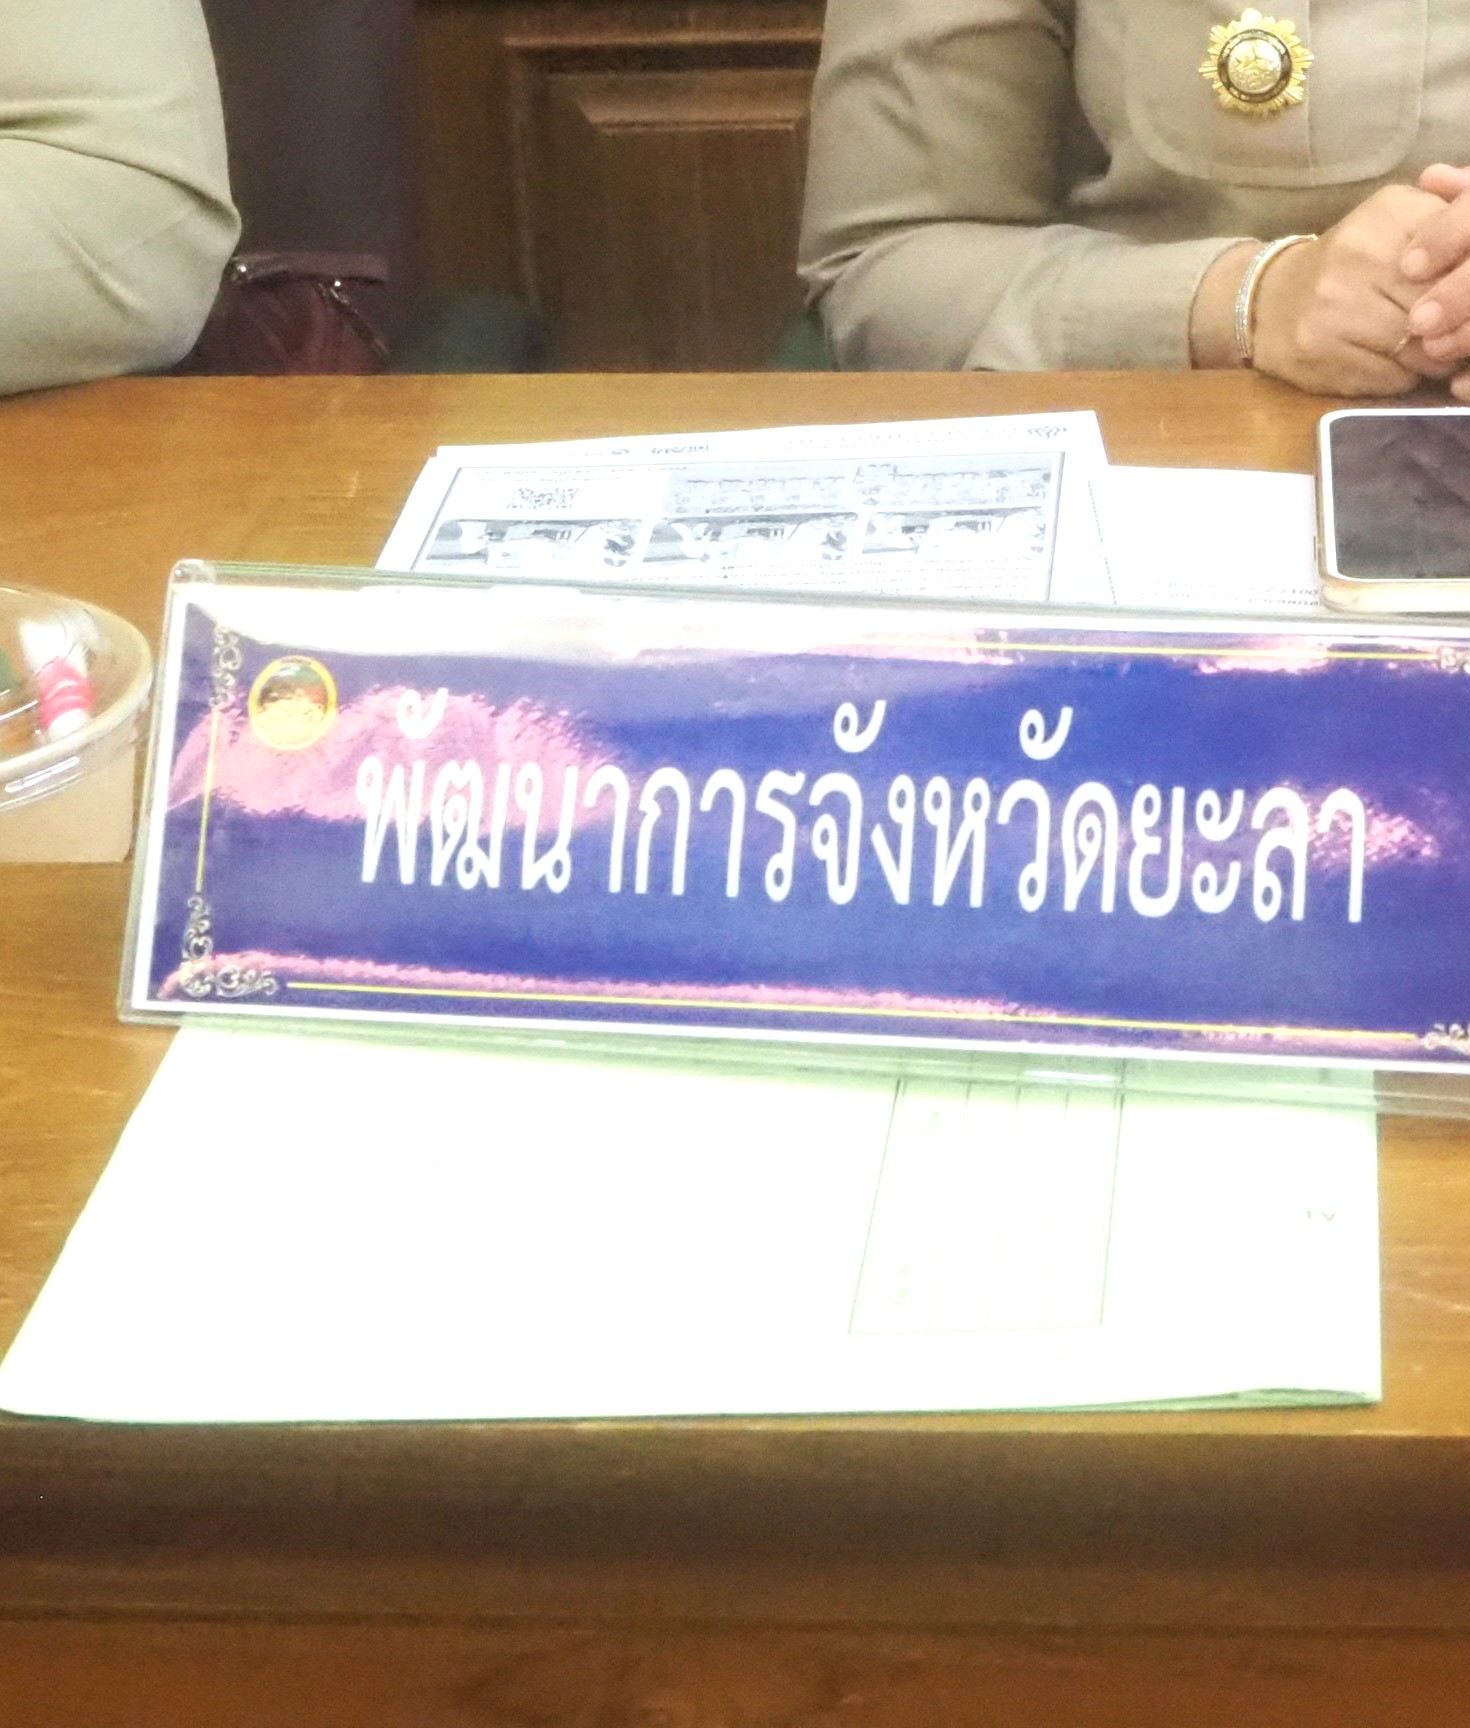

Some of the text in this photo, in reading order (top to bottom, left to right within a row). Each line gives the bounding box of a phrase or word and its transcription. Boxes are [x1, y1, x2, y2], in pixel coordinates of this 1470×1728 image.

[354, 690, 1370, 926] พัฒนาการจังหวัดยะลา
